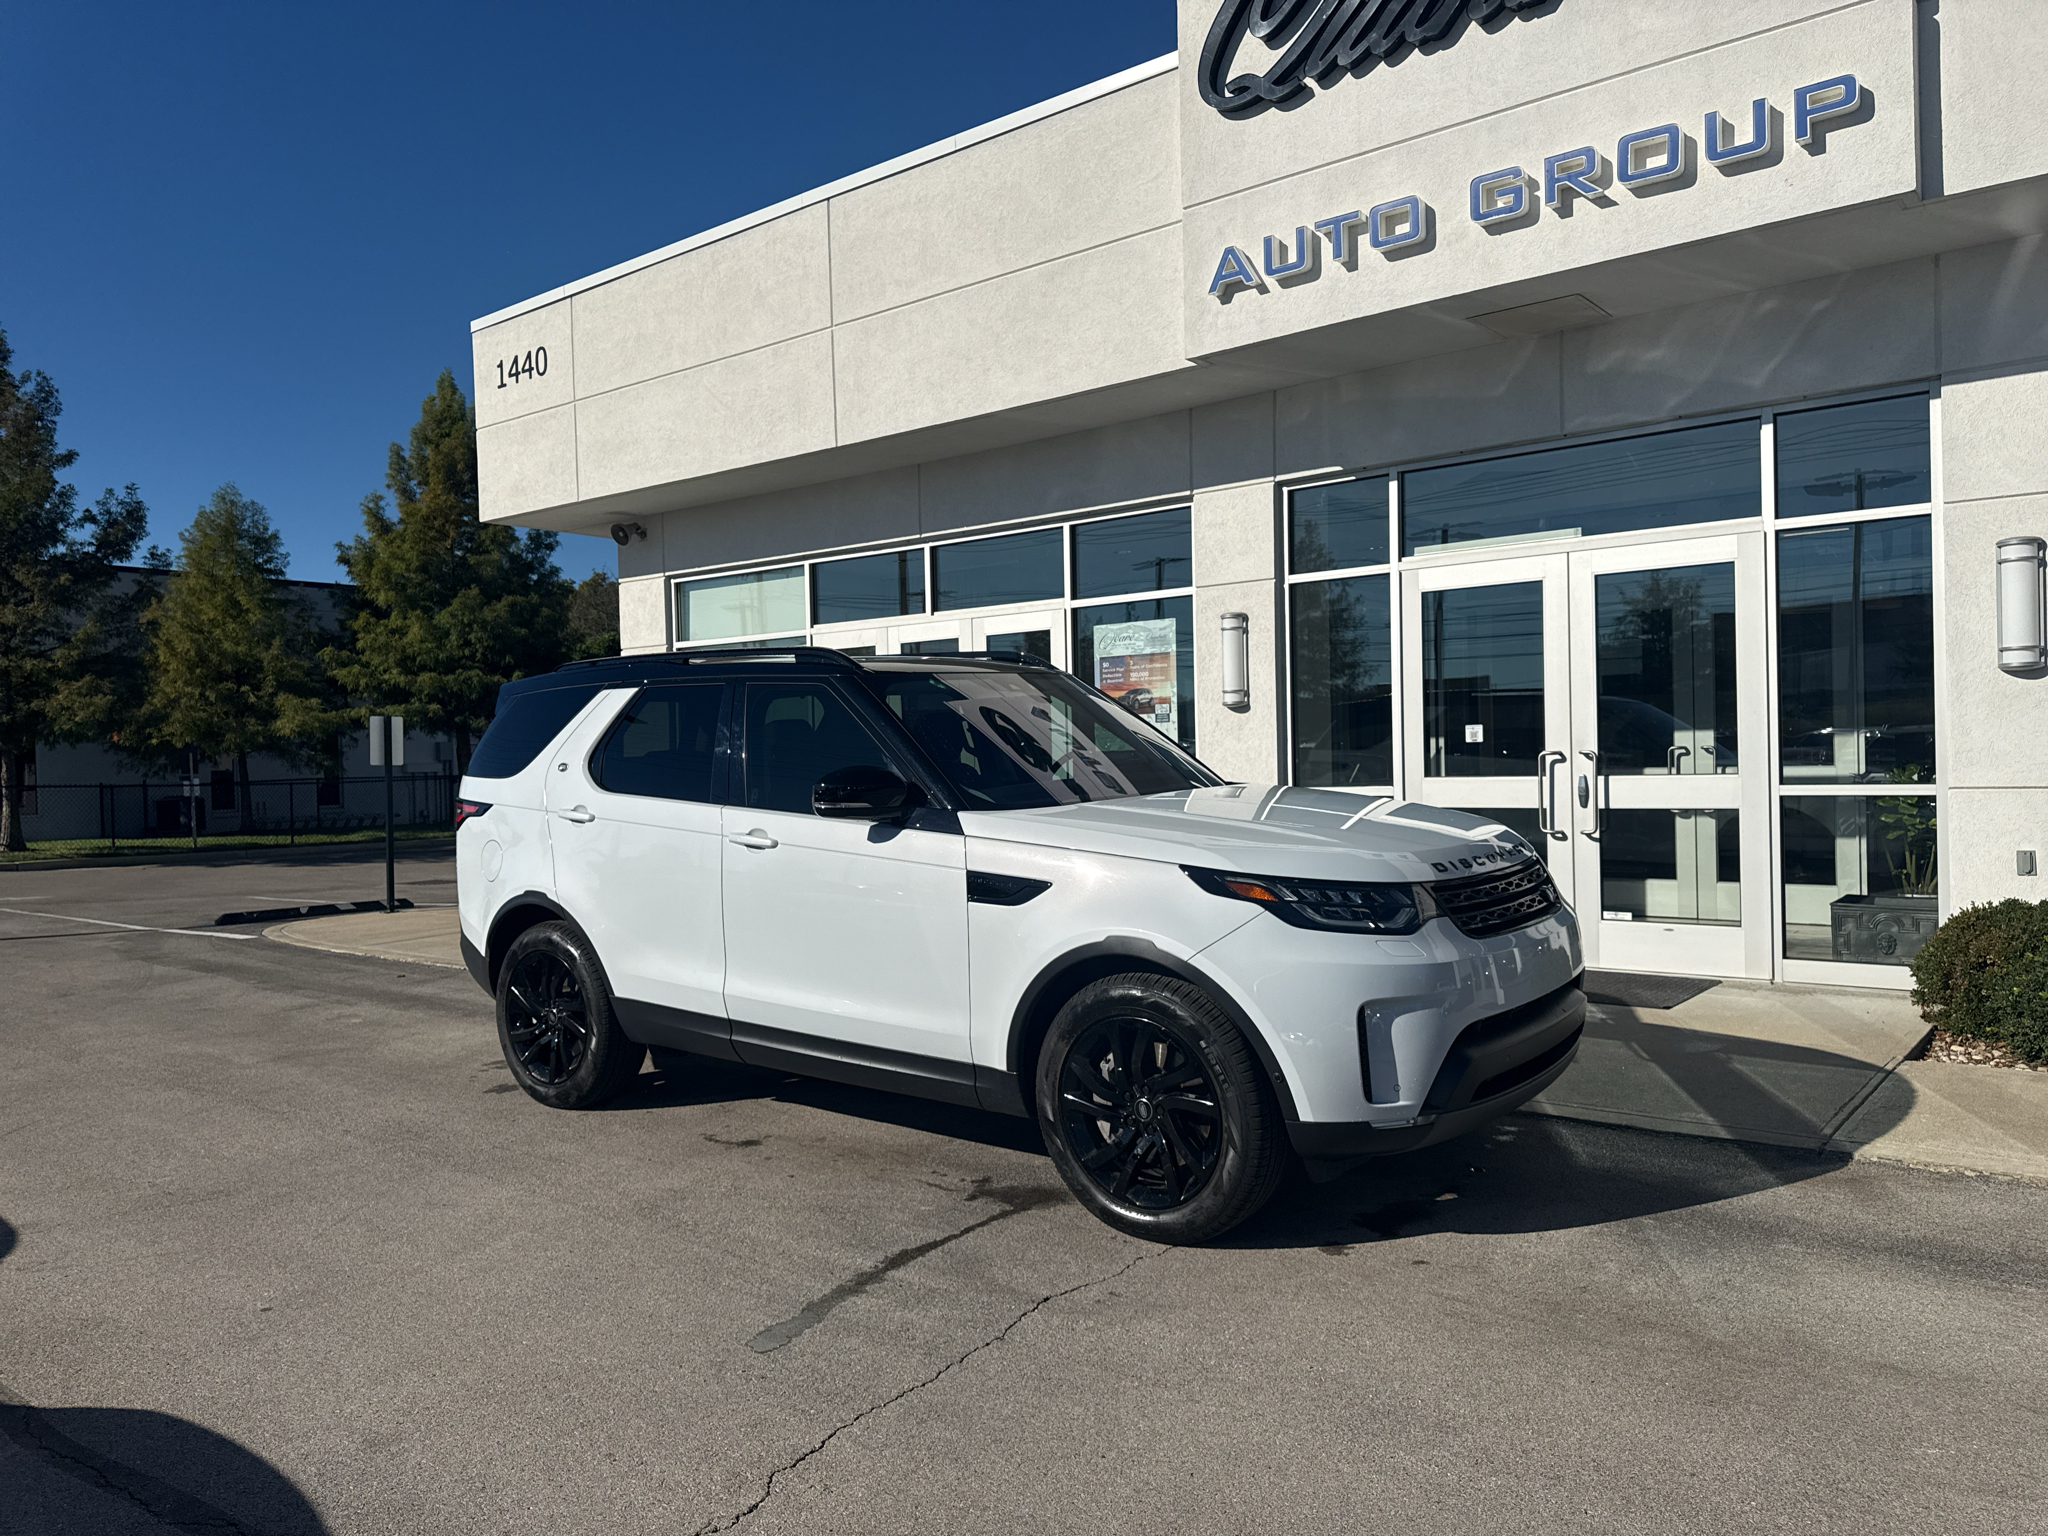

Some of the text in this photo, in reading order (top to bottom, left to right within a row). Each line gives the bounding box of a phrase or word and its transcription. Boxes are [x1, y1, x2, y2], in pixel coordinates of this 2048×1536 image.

[1208, 73, 1861, 296] AUTO GROUP
[496, 346, 548, 389] 1440
[1430, 841, 1528, 874] DISCOVERY
